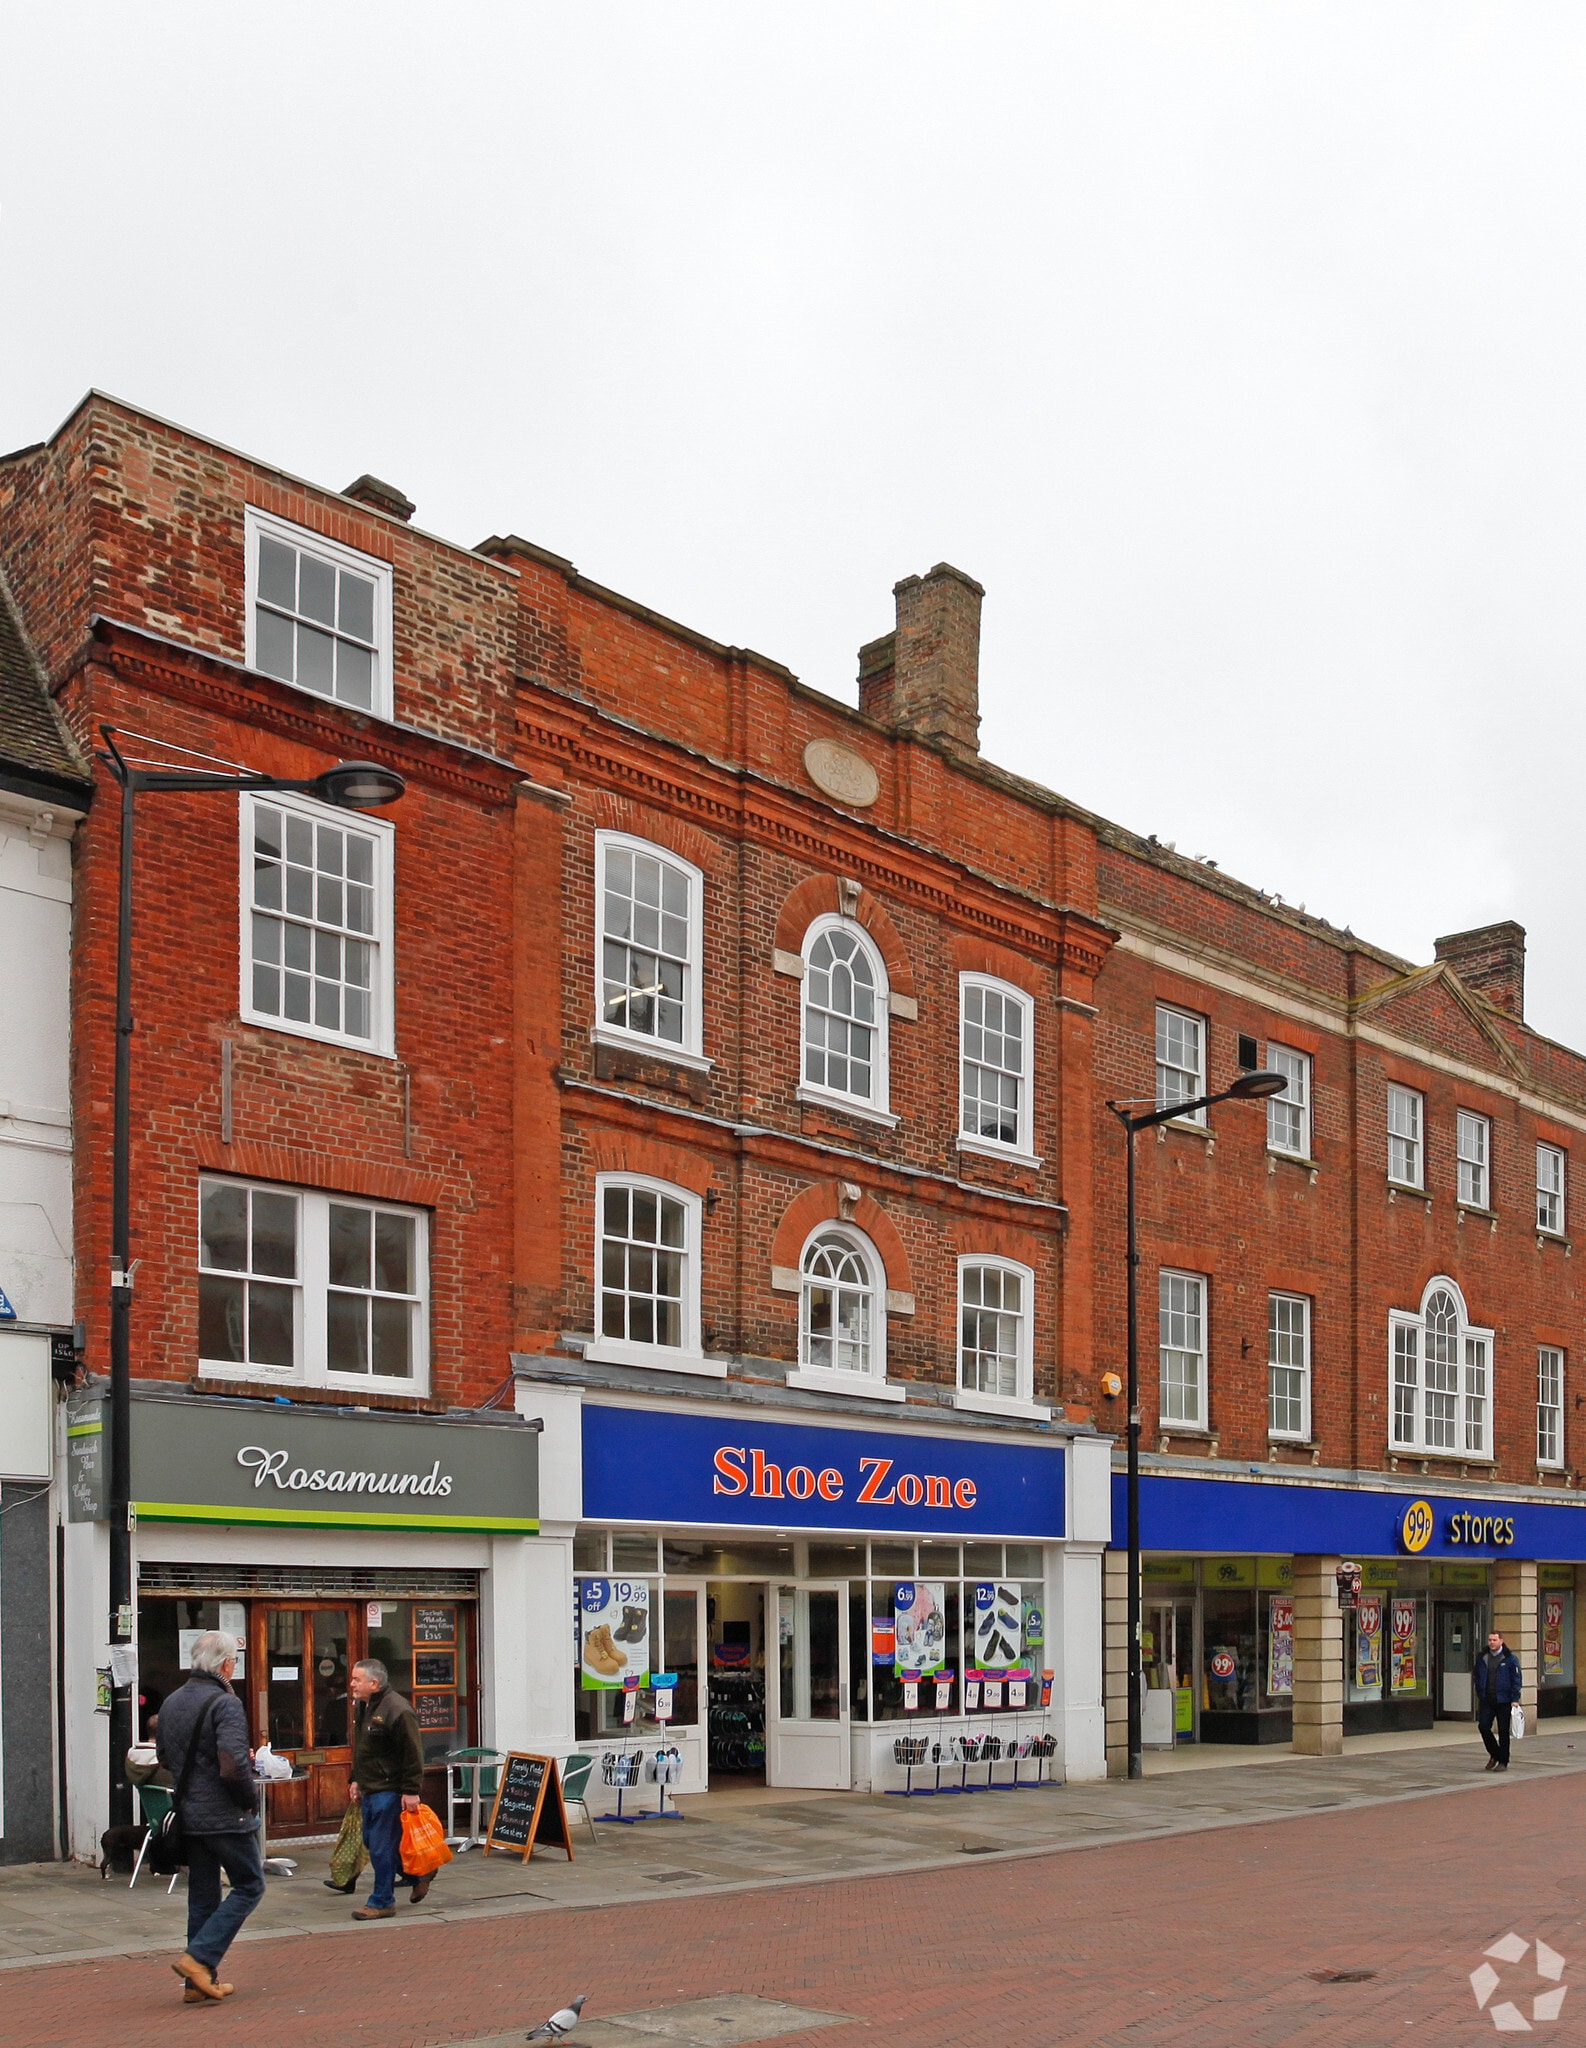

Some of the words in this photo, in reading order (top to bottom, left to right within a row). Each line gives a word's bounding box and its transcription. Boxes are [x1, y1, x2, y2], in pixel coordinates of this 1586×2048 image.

[71, 1440, 98, 1456] Sandwich
[237, 1446, 453, 1496] Rosamunds
[713, 1446, 844, 1501] Shoe
[856, 1457, 977, 1508] Zone
[72, 1483, 91, 1497] Coffee
[80, 1497, 98, 1514] Shop
[1408, 1507, 1431, 1545] 99p
[1451, 1510, 1514, 1545] stores
[586, 1582, 602, 1599] £5
[613, 1583, 647, 1602] 19.99
[897, 1588, 913, 1600] 6.99
[976, 1588, 994, 1600] 12.99
[587, 1602, 601, 1611] off
